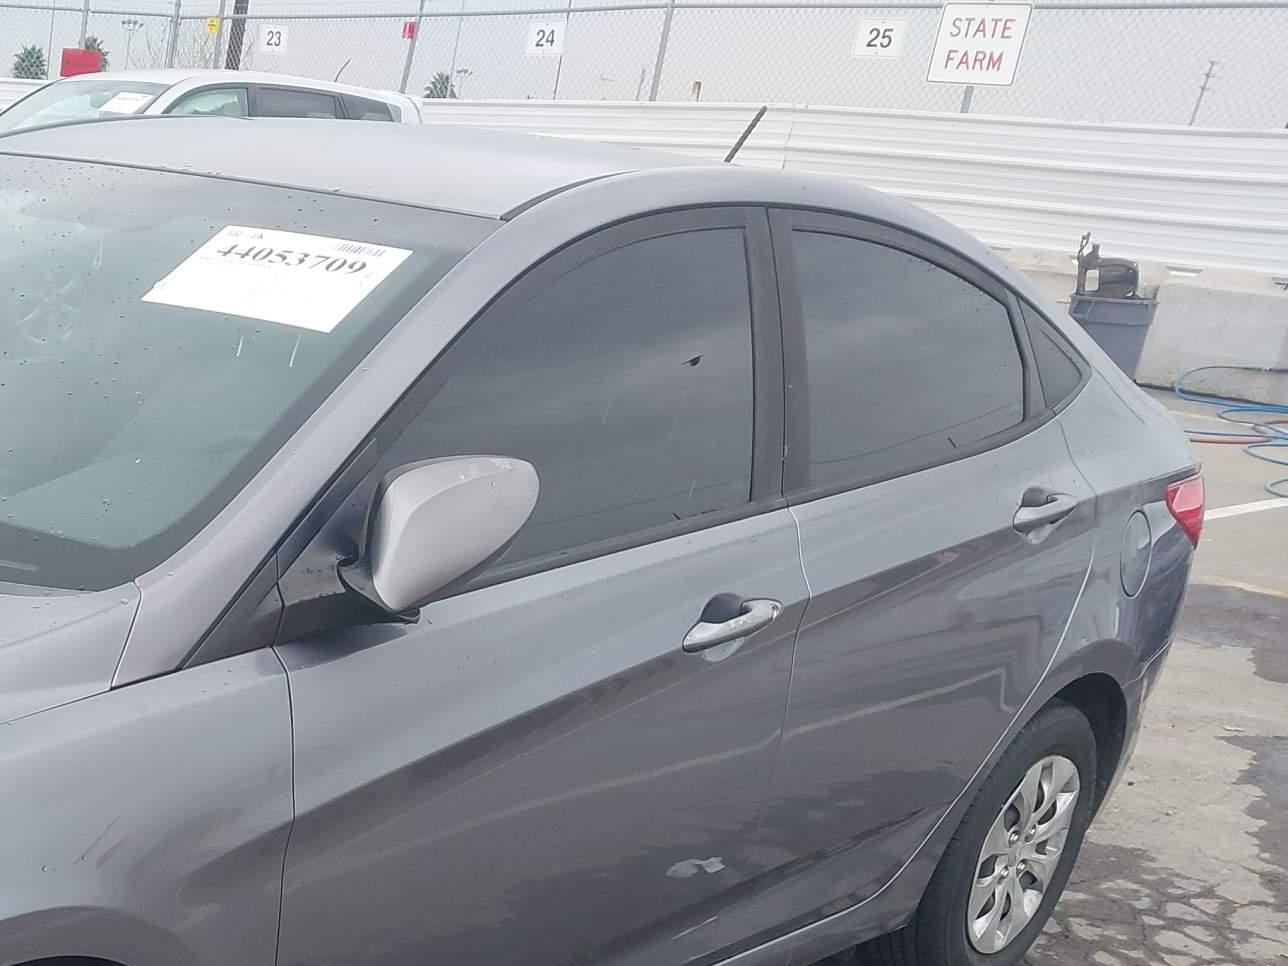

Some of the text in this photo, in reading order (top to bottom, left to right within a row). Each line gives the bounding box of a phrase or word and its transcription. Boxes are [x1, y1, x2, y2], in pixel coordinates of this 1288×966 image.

[266, 30, 282, 47] 23
[535, 29, 555, 47] 24
[866, 27, 894, 48] 25
[950, 17, 1016, 39] STATE
[944, 49, 1004, 72] FARM
[216, 243, 367, 275] 44053709
